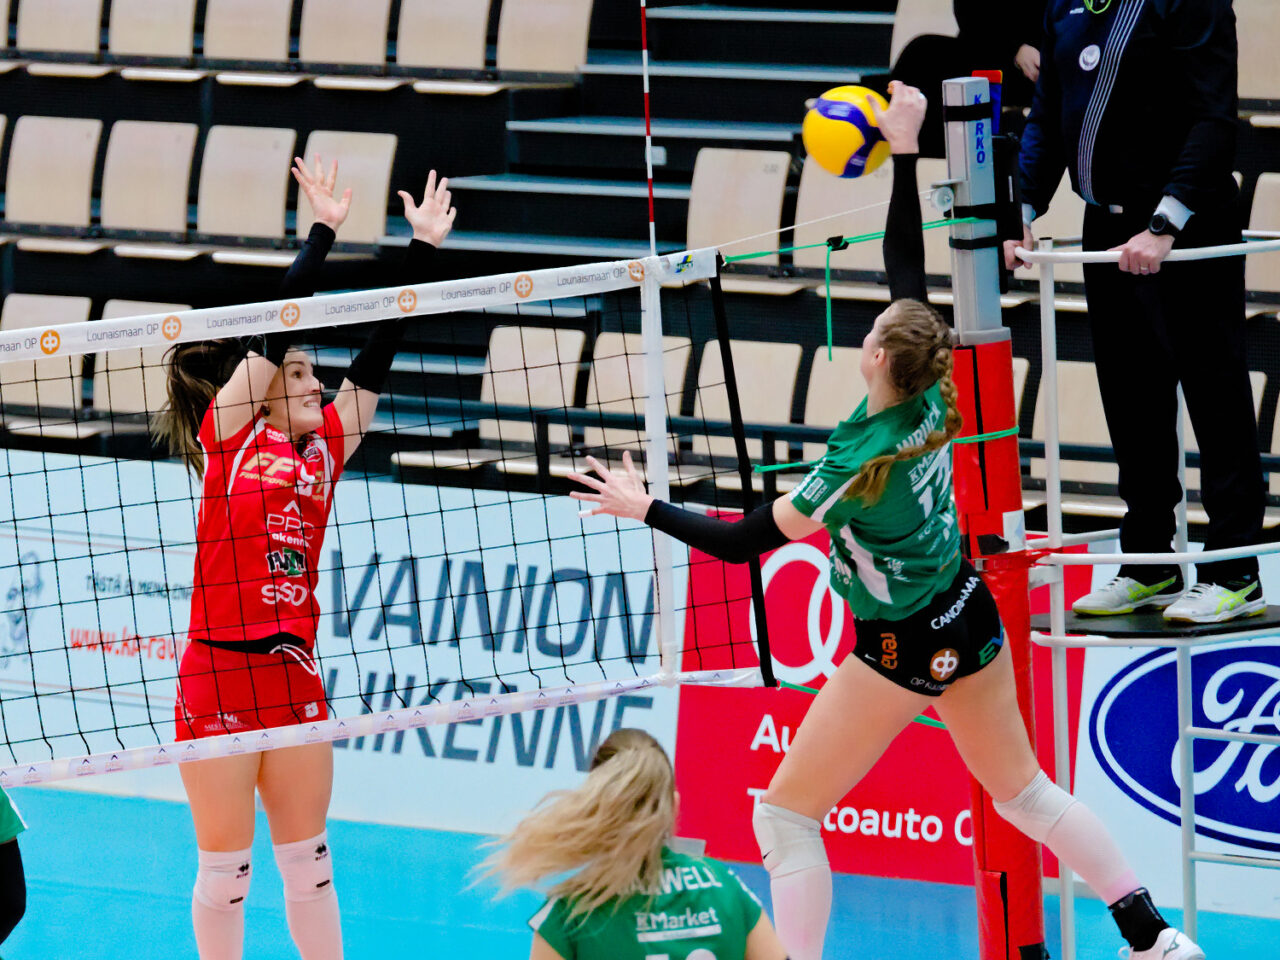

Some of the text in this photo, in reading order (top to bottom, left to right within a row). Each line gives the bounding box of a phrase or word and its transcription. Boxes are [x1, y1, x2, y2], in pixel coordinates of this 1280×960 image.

[974, 94, 987, 164] KRKO
[556, 270, 611, 286] Lounaismaan
[440, 285, 496, 300] Lounaismaan
[326, 301, 380, 314] Lounaismaan
[207, 312, 263, 328] Lounaismaan
[88, 329, 143, 341] Lounaismaan
[331, 550, 656, 665] VAINION
